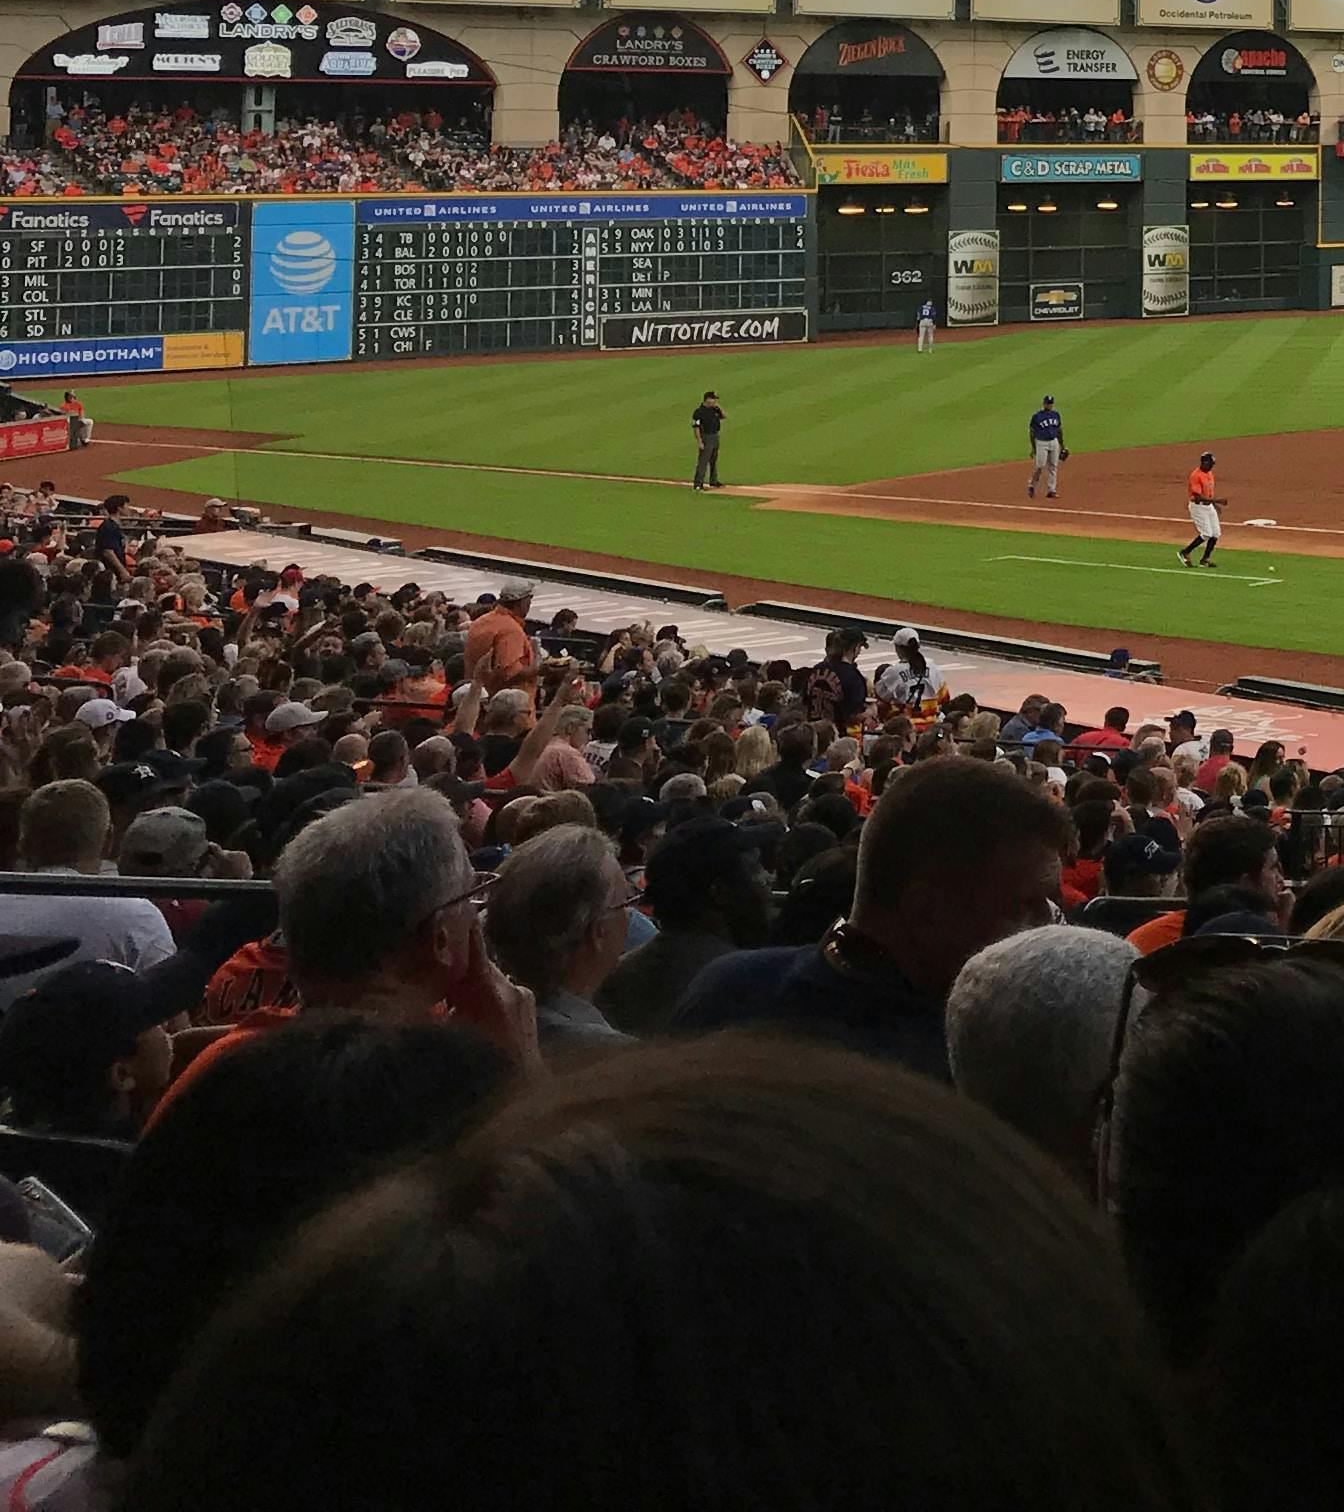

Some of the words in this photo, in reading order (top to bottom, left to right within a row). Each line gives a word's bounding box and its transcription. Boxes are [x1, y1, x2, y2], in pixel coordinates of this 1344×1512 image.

[218, 23, 319, 40] LANDRY'S
[616, 39, 683, 50] LANDRY'S
[593, 55, 664, 66] CRAWFORD
[669, 56, 707, 67] BOXES
[1067, 49, 1106, 61] ENERGY
[1067, 61, 1118, 74] TRANSFER
[843, 159, 890, 180] Fiesta
[1011, 161, 1022, 176] C
[1037, 161, 1049, 175] D
[1054, 161, 1092, 175] SCRAP
[1095, 160, 1131, 174] METAL
[438, 205, 497, 215] AIRLINES
[531, 204, 577, 213] UNITED
[594, 204, 649, 213] AIRLINES
[681, 203, 724, 212] UNITED
[739, 202, 792, 211] AIRLINES
[11, 211, 90, 228] Fanatics
[150, 209, 223, 227] Fanatics
[399, 233, 412, 244] TB
[30, 240, 45, 253] SF
[394, 247, 415, 258] BAL
[27, 256, 48, 269] PIT
[1148, 253, 1185, 268] WM
[394, 264, 416, 275] BOS
[24, 274, 48, 287] MIL
[394, 278, 416, 290] TOR
[891, 270, 922, 285] 362
[585, 234, 595, 340] AMERICAN
[23, 290, 49, 303] COL
[397, 295, 412, 307] KC
[631, 301, 652, 312] LAA
[25, 309, 47, 322] STL
[262, 305, 341, 334] AT&T
[393, 309, 413, 321] CLE
[27, 325, 44, 337] SD
[390, 326, 416, 339] CWS
[632, 317, 779, 343] NITTOTIRE.COM
[393, 341, 412, 353] CHI
[18, 347, 154, 365] HIGGINBOTHAM
